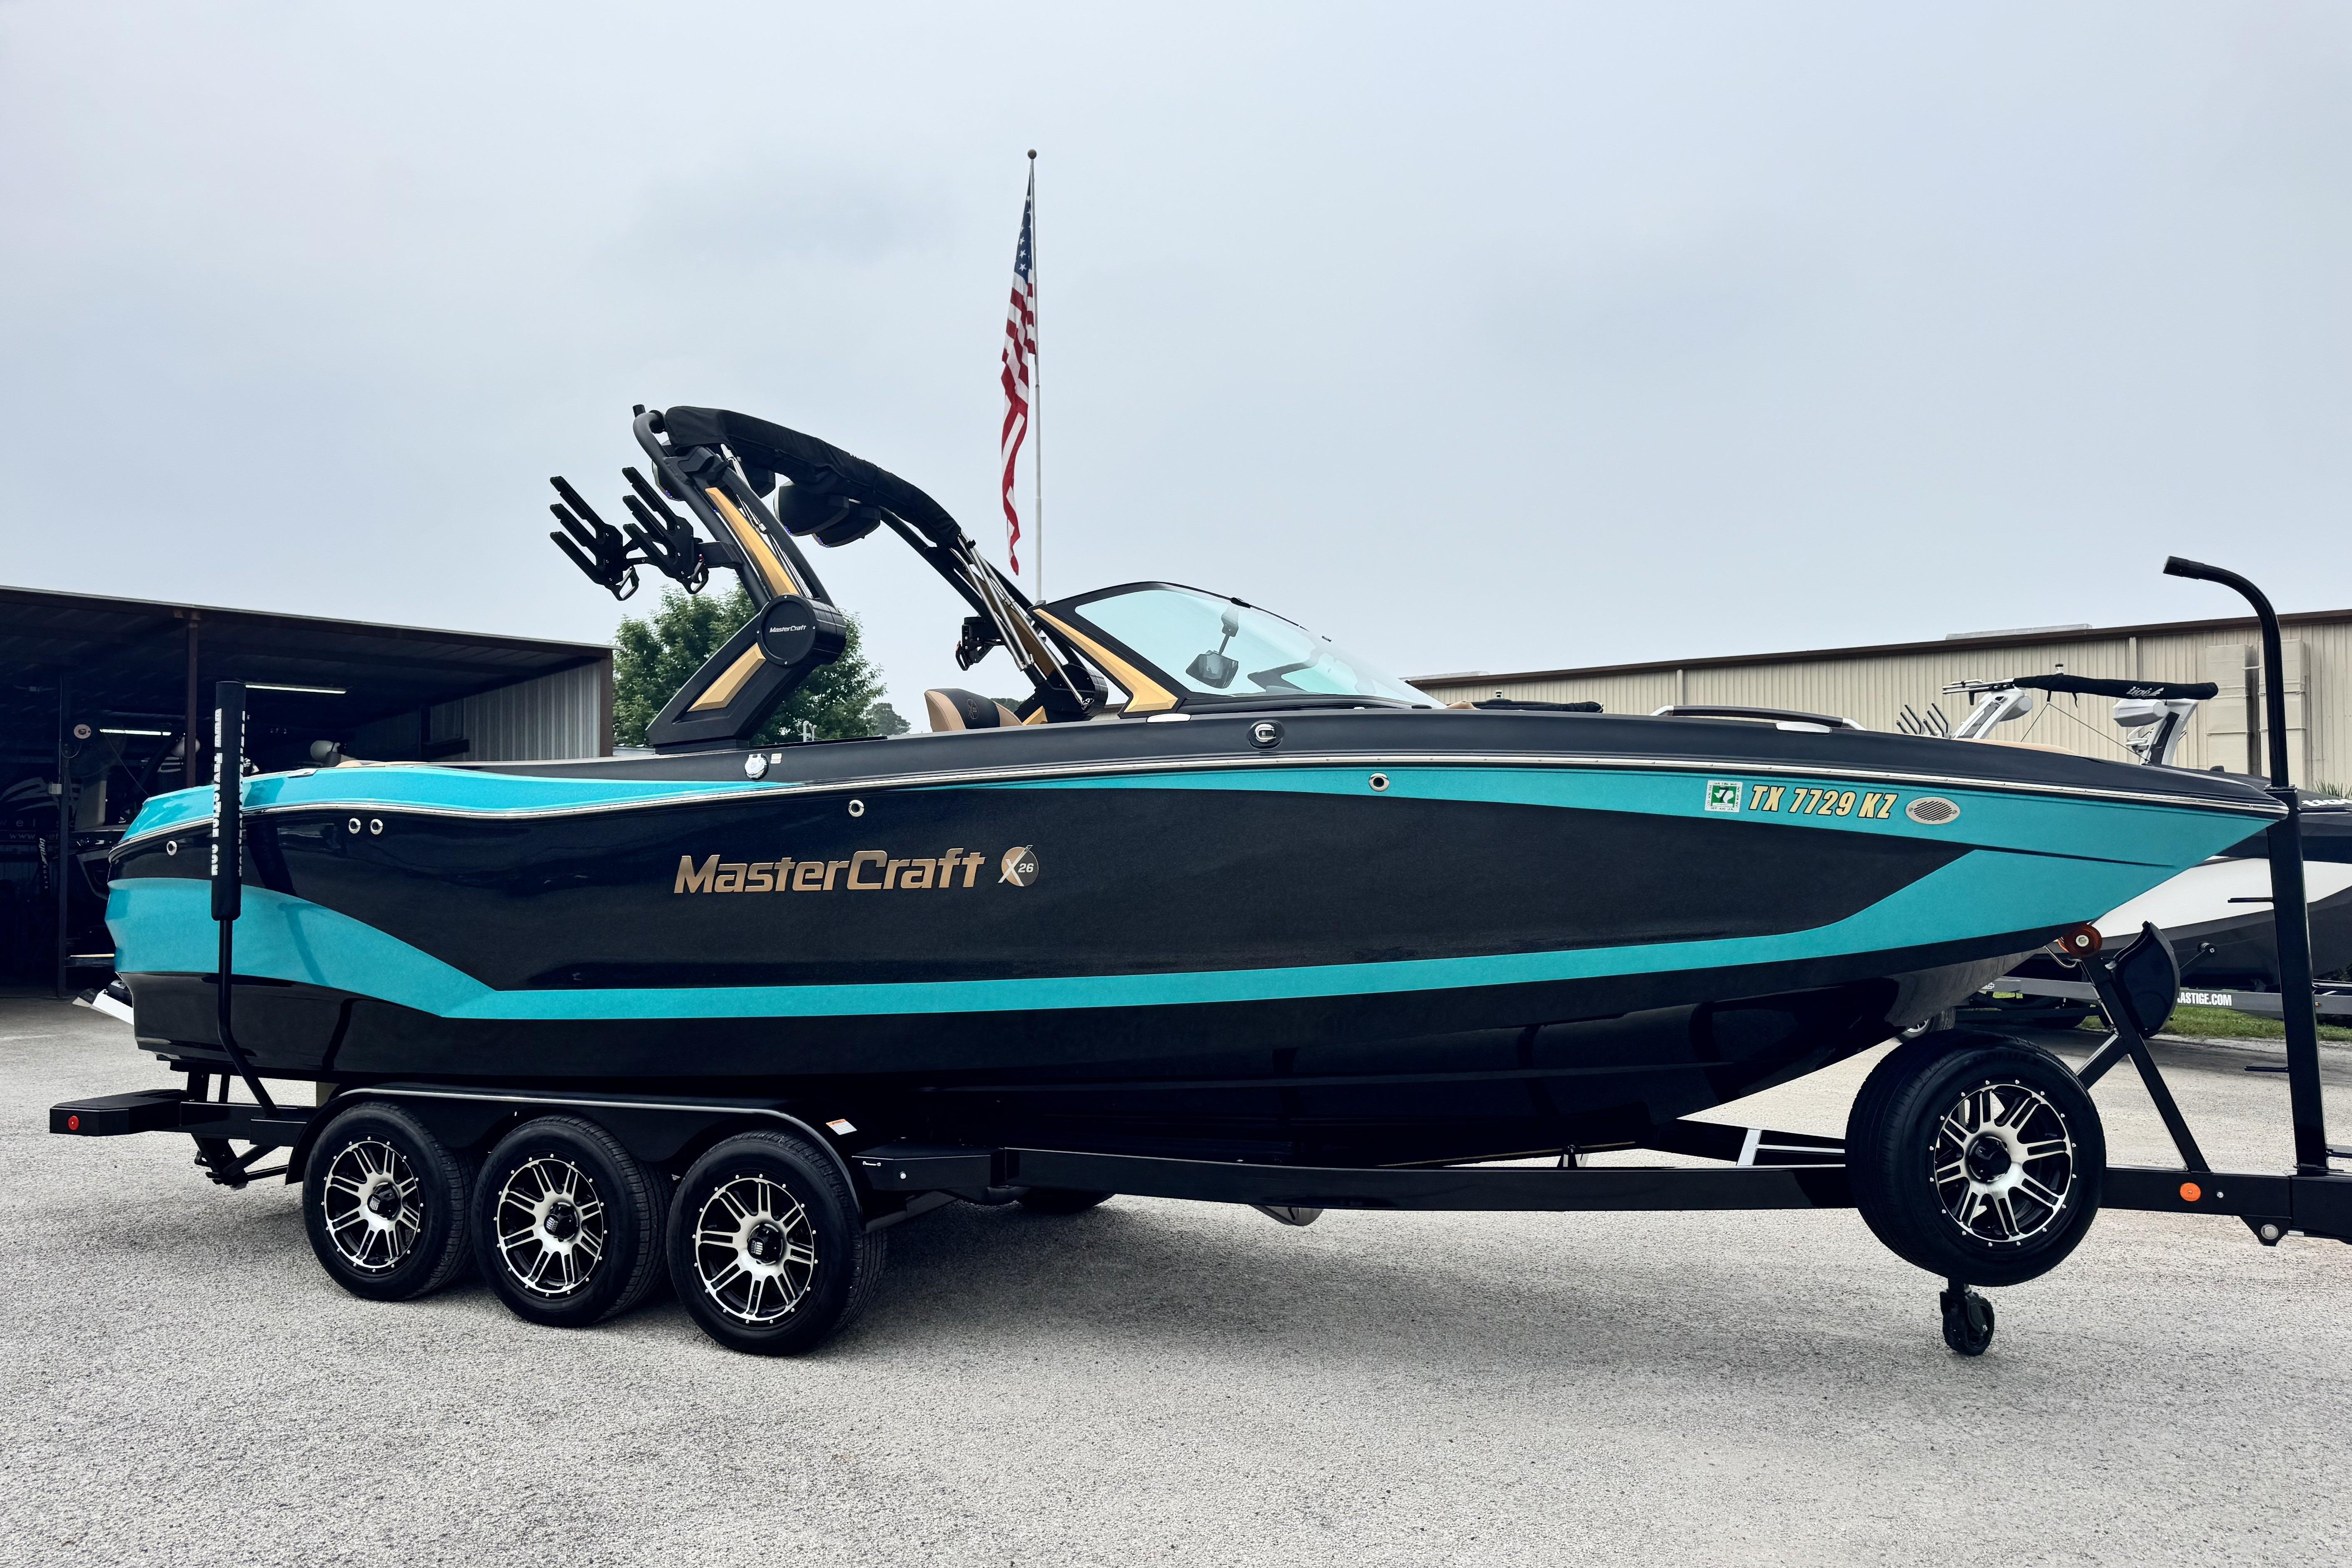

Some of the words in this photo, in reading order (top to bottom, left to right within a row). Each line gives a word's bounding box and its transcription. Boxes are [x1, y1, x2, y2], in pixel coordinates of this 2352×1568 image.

[1749, 784, 1786, 812] TX
[1788, 787, 1857, 816] 7729
[1857, 792, 1899, 819] KZ
[673, 848, 986, 894] MasterCraft
